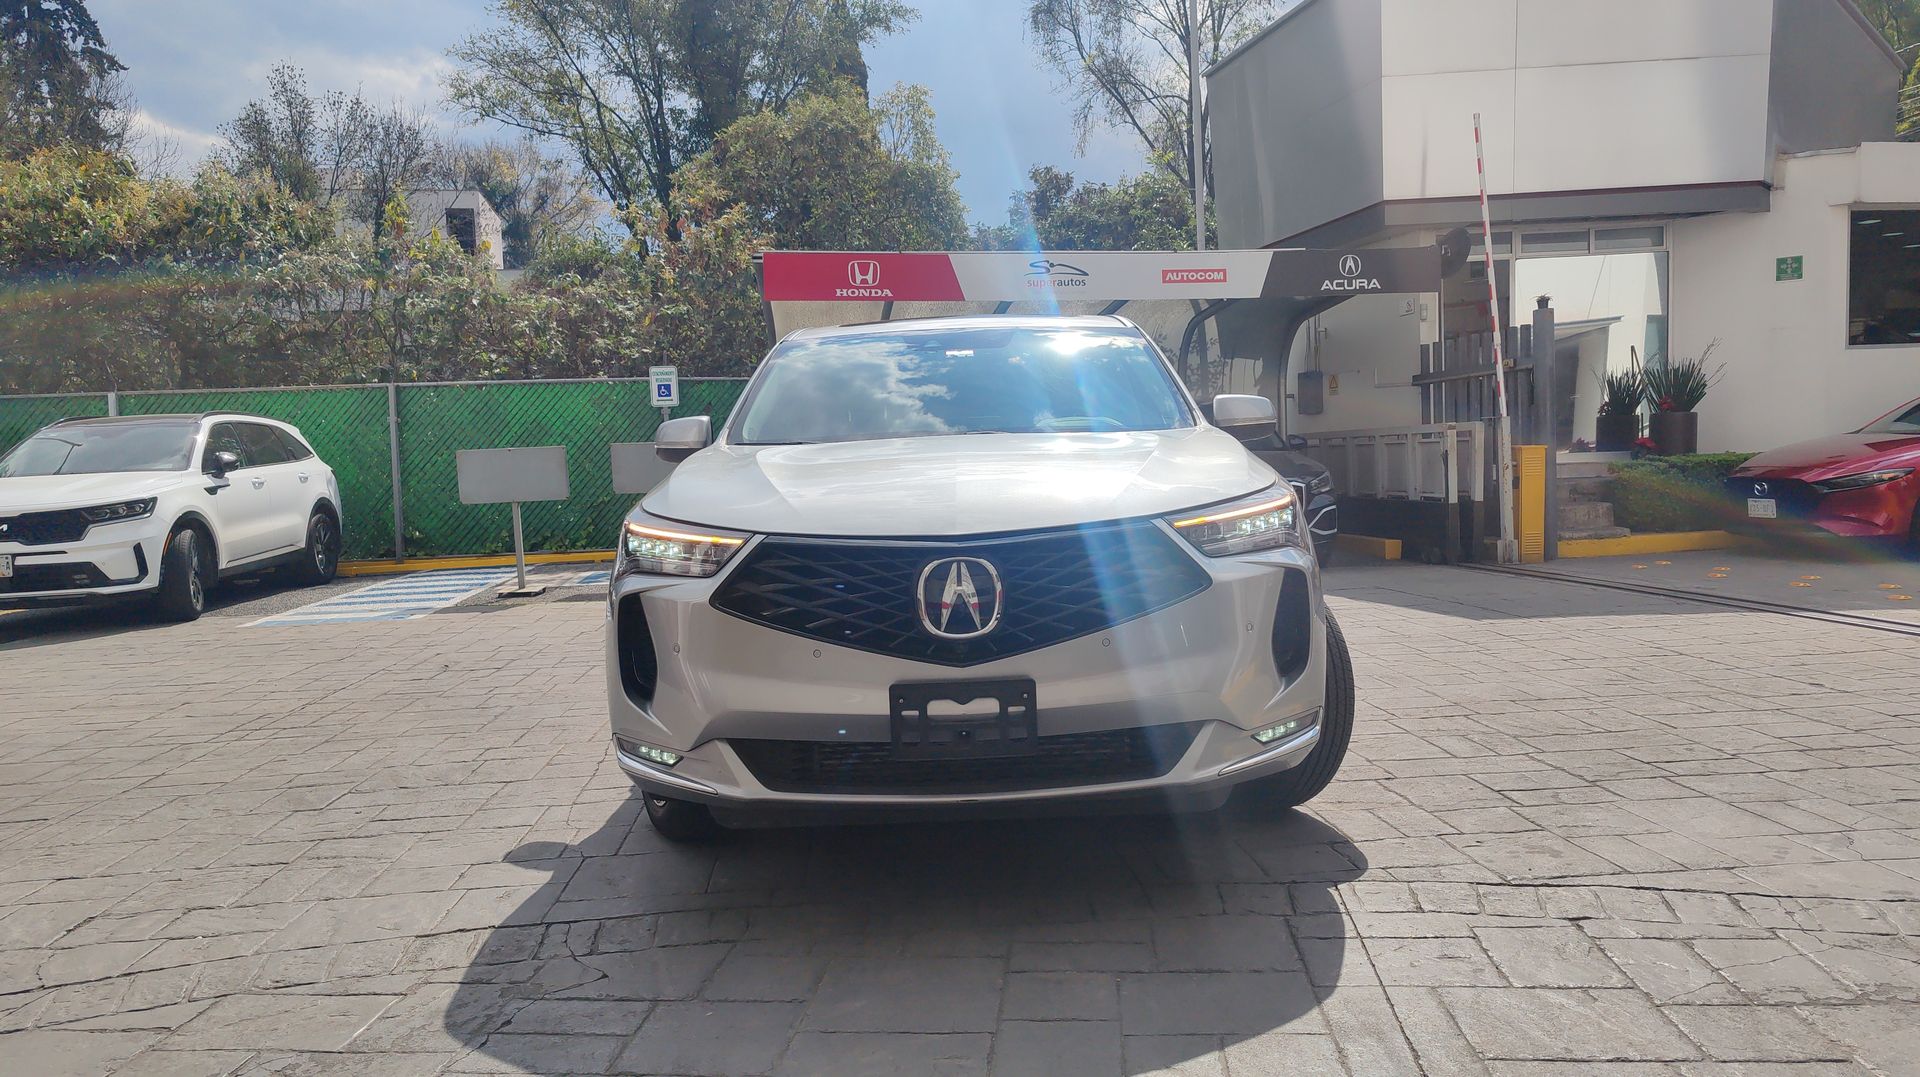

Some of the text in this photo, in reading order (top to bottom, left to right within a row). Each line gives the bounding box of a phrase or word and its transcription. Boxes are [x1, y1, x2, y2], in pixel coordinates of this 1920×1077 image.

[1165, 271, 1224, 282] AUTOCOM
[1027, 278, 1086, 289] superautos
[1320, 278, 1381, 291] ACURA
[835, 288, 893, 297] HONDA
